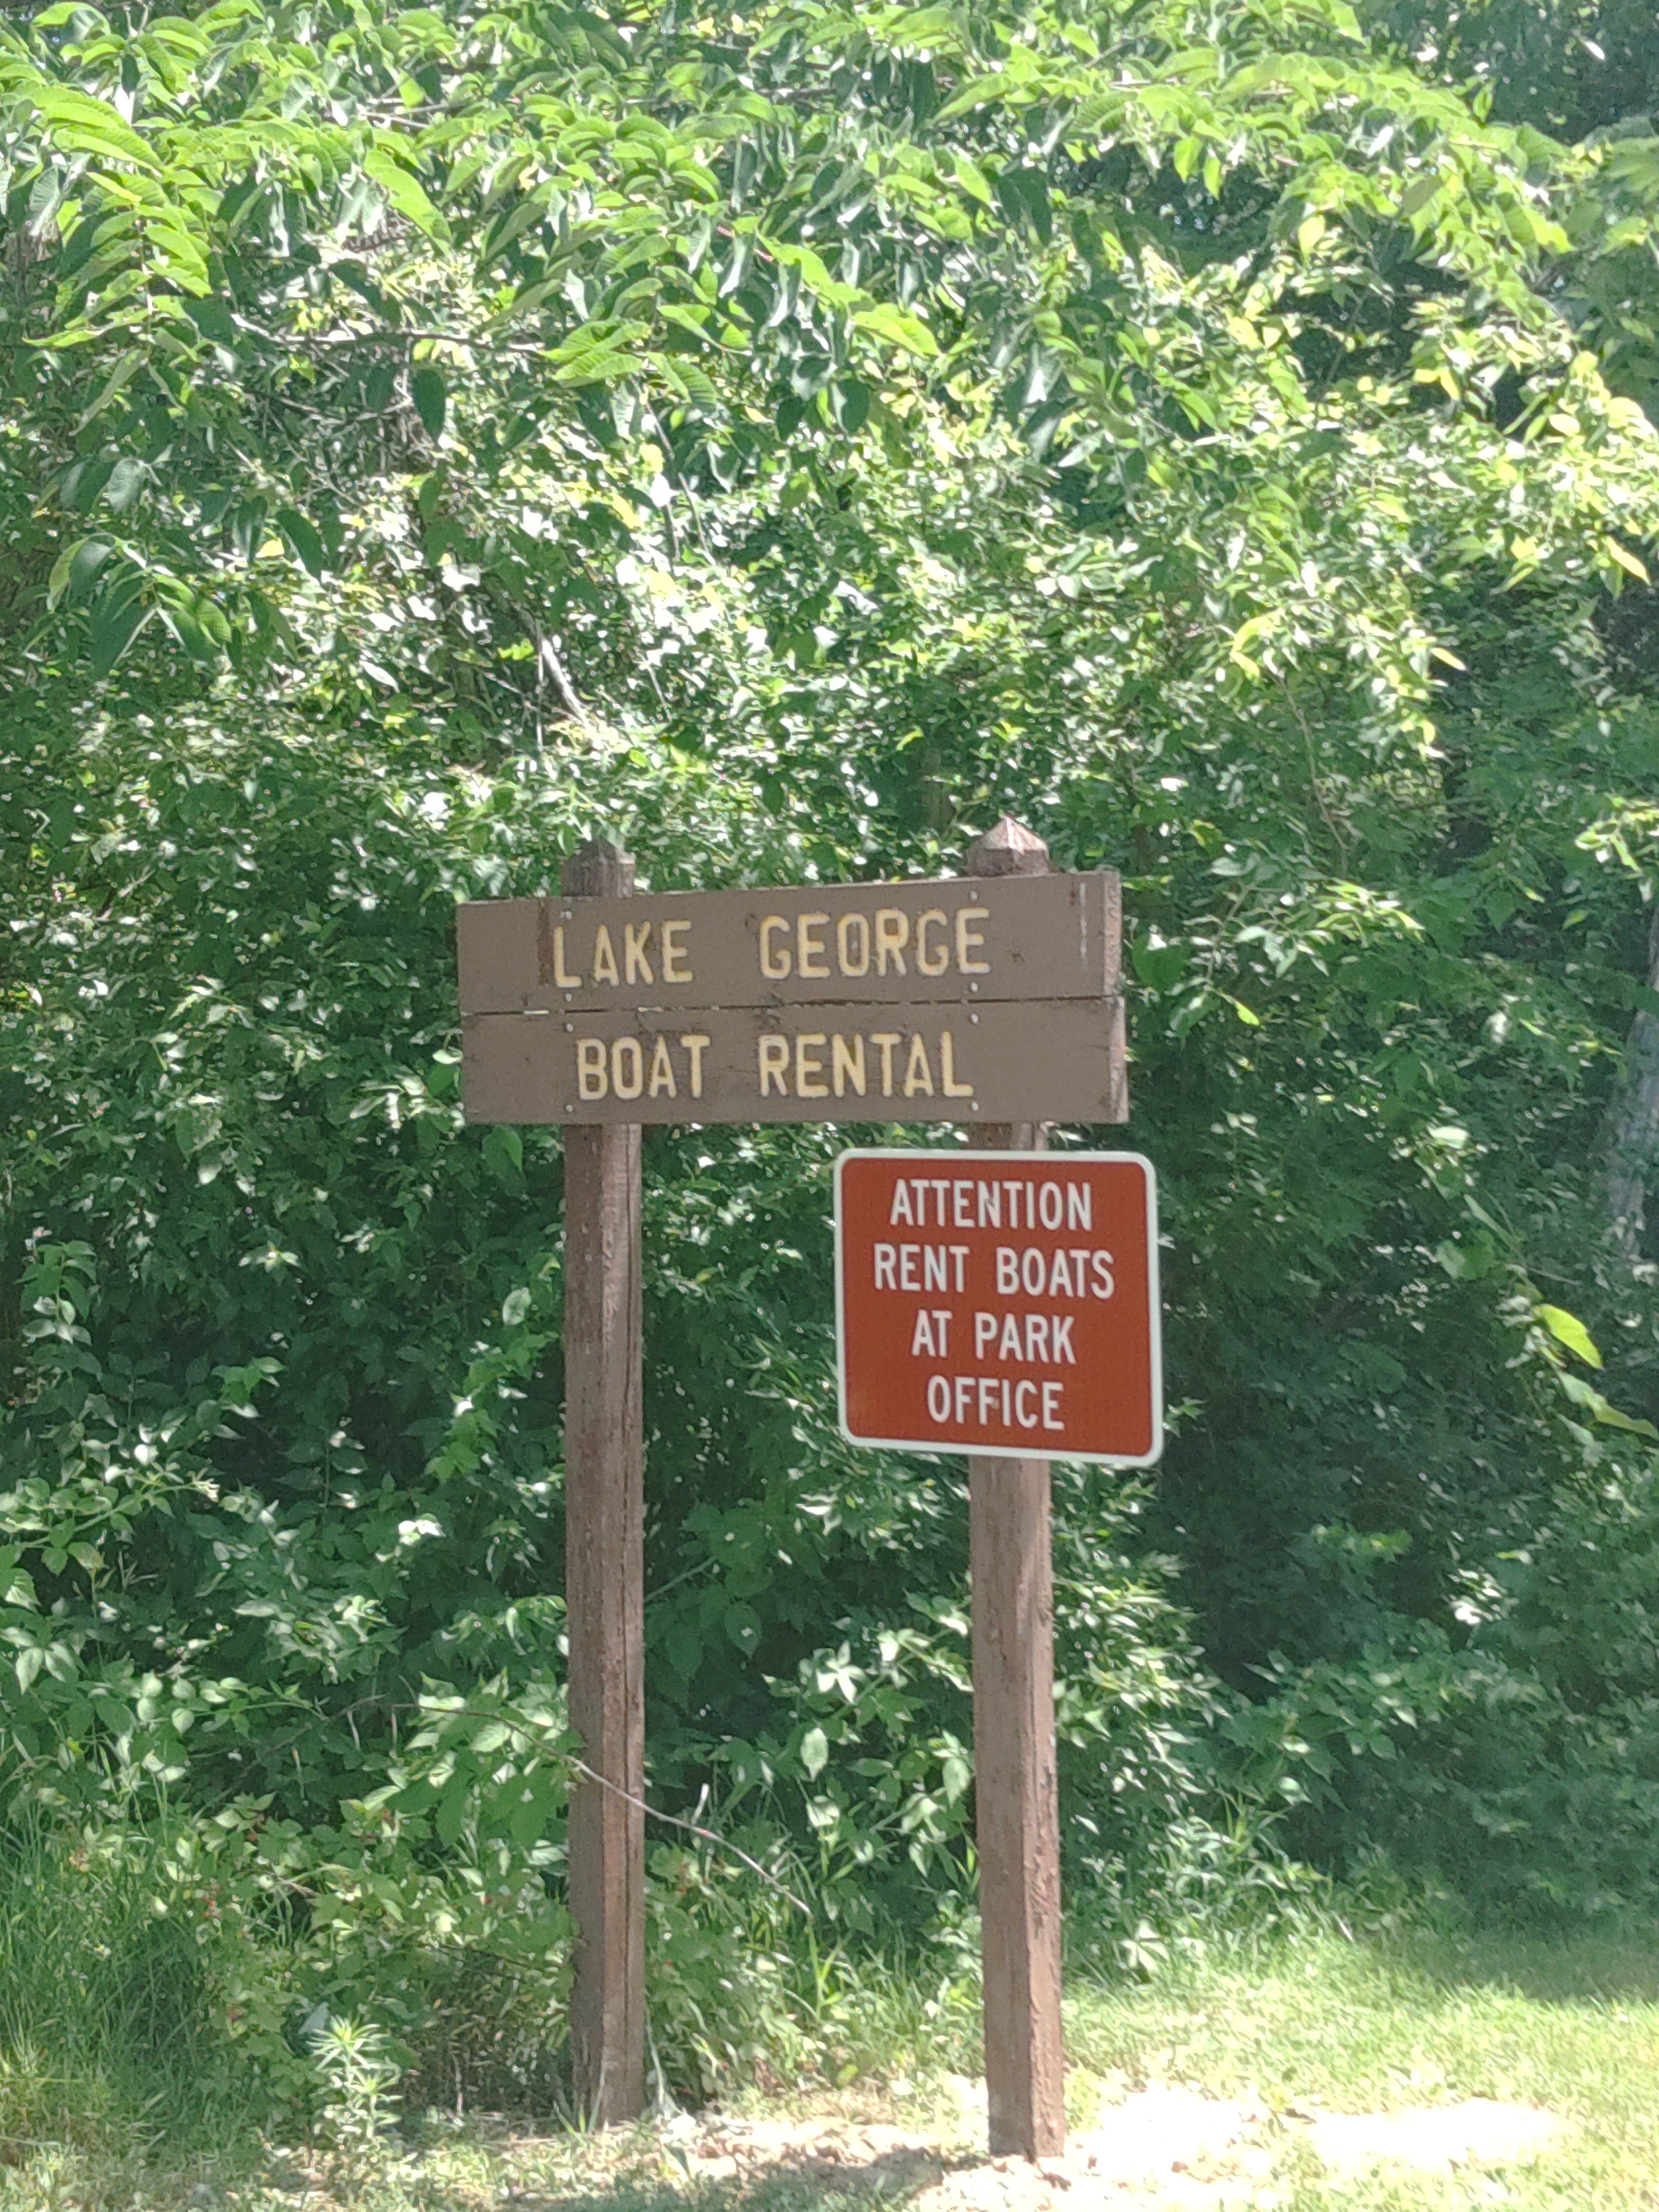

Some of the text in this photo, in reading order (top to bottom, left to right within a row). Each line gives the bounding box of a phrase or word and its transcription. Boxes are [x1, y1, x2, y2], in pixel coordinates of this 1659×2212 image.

[553, 907, 991, 988] LAKE GEORGE
[576, 1031, 974, 1101] BOAT RENTAL
[890, 1179, 1092, 1231] ATTENTION
[874, 1243, 1115, 1299] RENT BOATS
[912, 1309, 1076, 1364] AT PARK
[927, 1375, 1065, 1431] OFFICE
